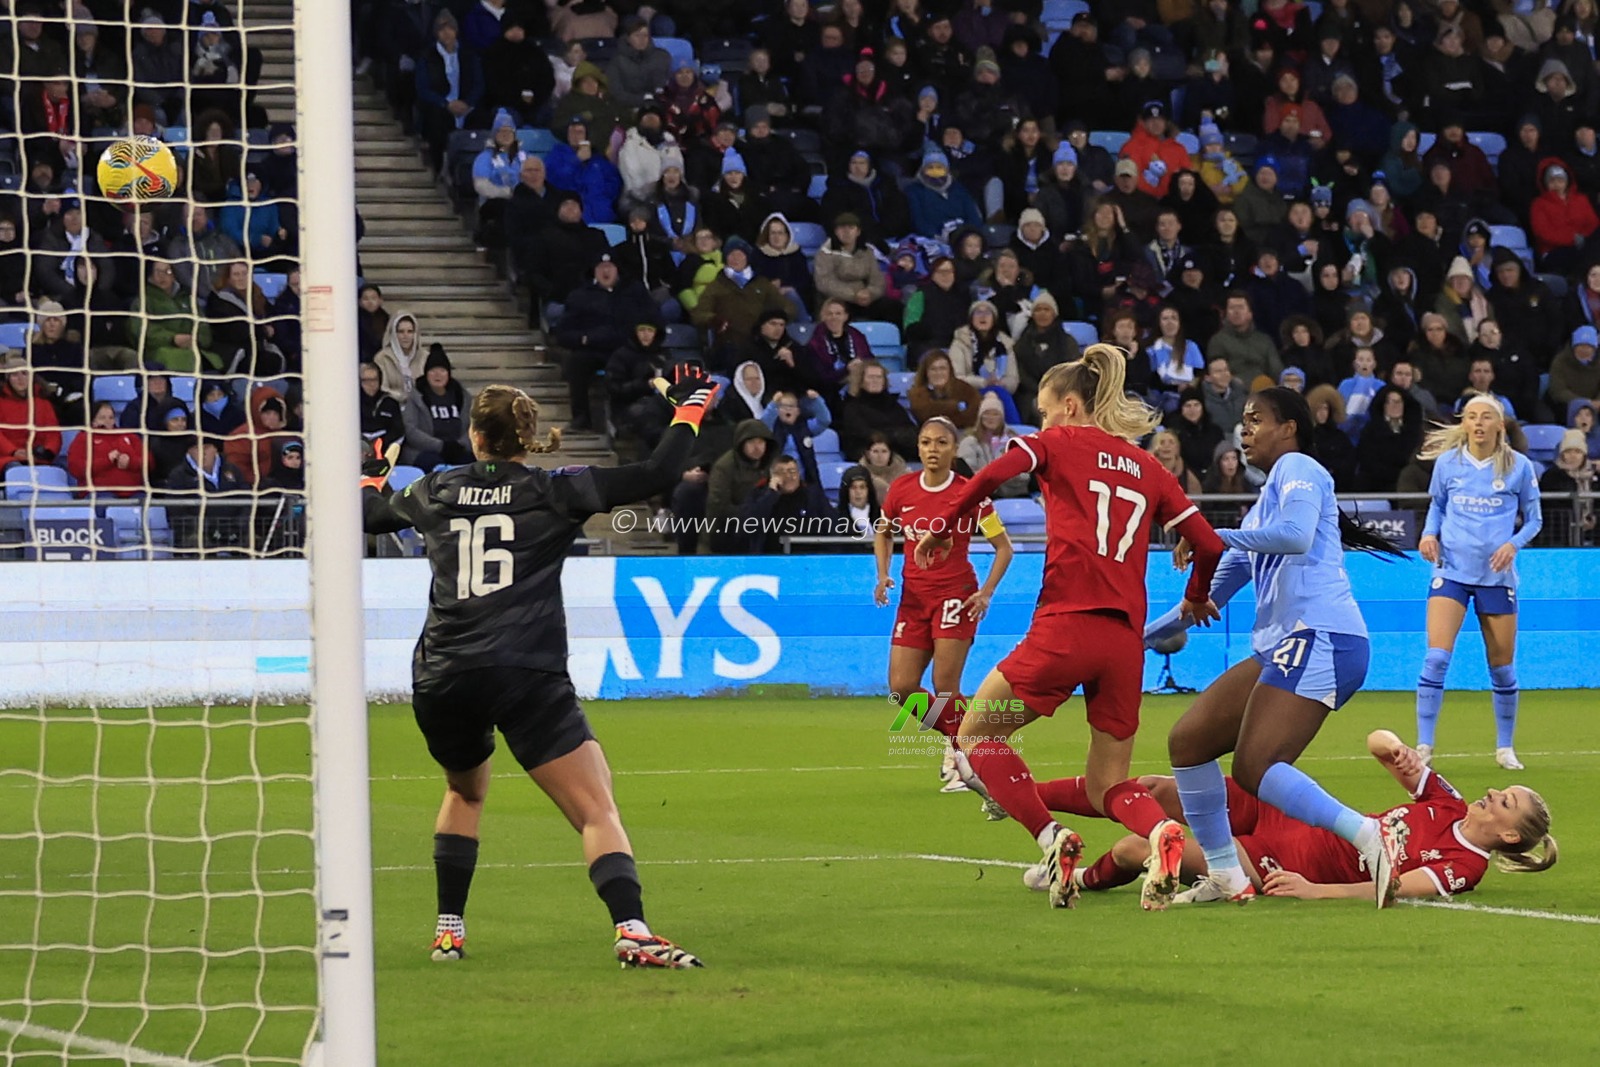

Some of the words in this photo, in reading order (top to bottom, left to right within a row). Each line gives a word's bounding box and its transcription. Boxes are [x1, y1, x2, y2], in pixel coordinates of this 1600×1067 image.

[1098, 451, 1141, 479] CLARK
[457, 485, 512, 505] MICAH
[1452, 495, 1503, 507] ETIHAD
[1088, 479, 1147, 563] 17
[1350, 519, 1406, 537] OCK
[36, 527, 104, 545] BLOCK
[450, 513, 515, 600] 16
[941, 598, 962, 624] 12
[1272, 637, 1307, 667] 21
